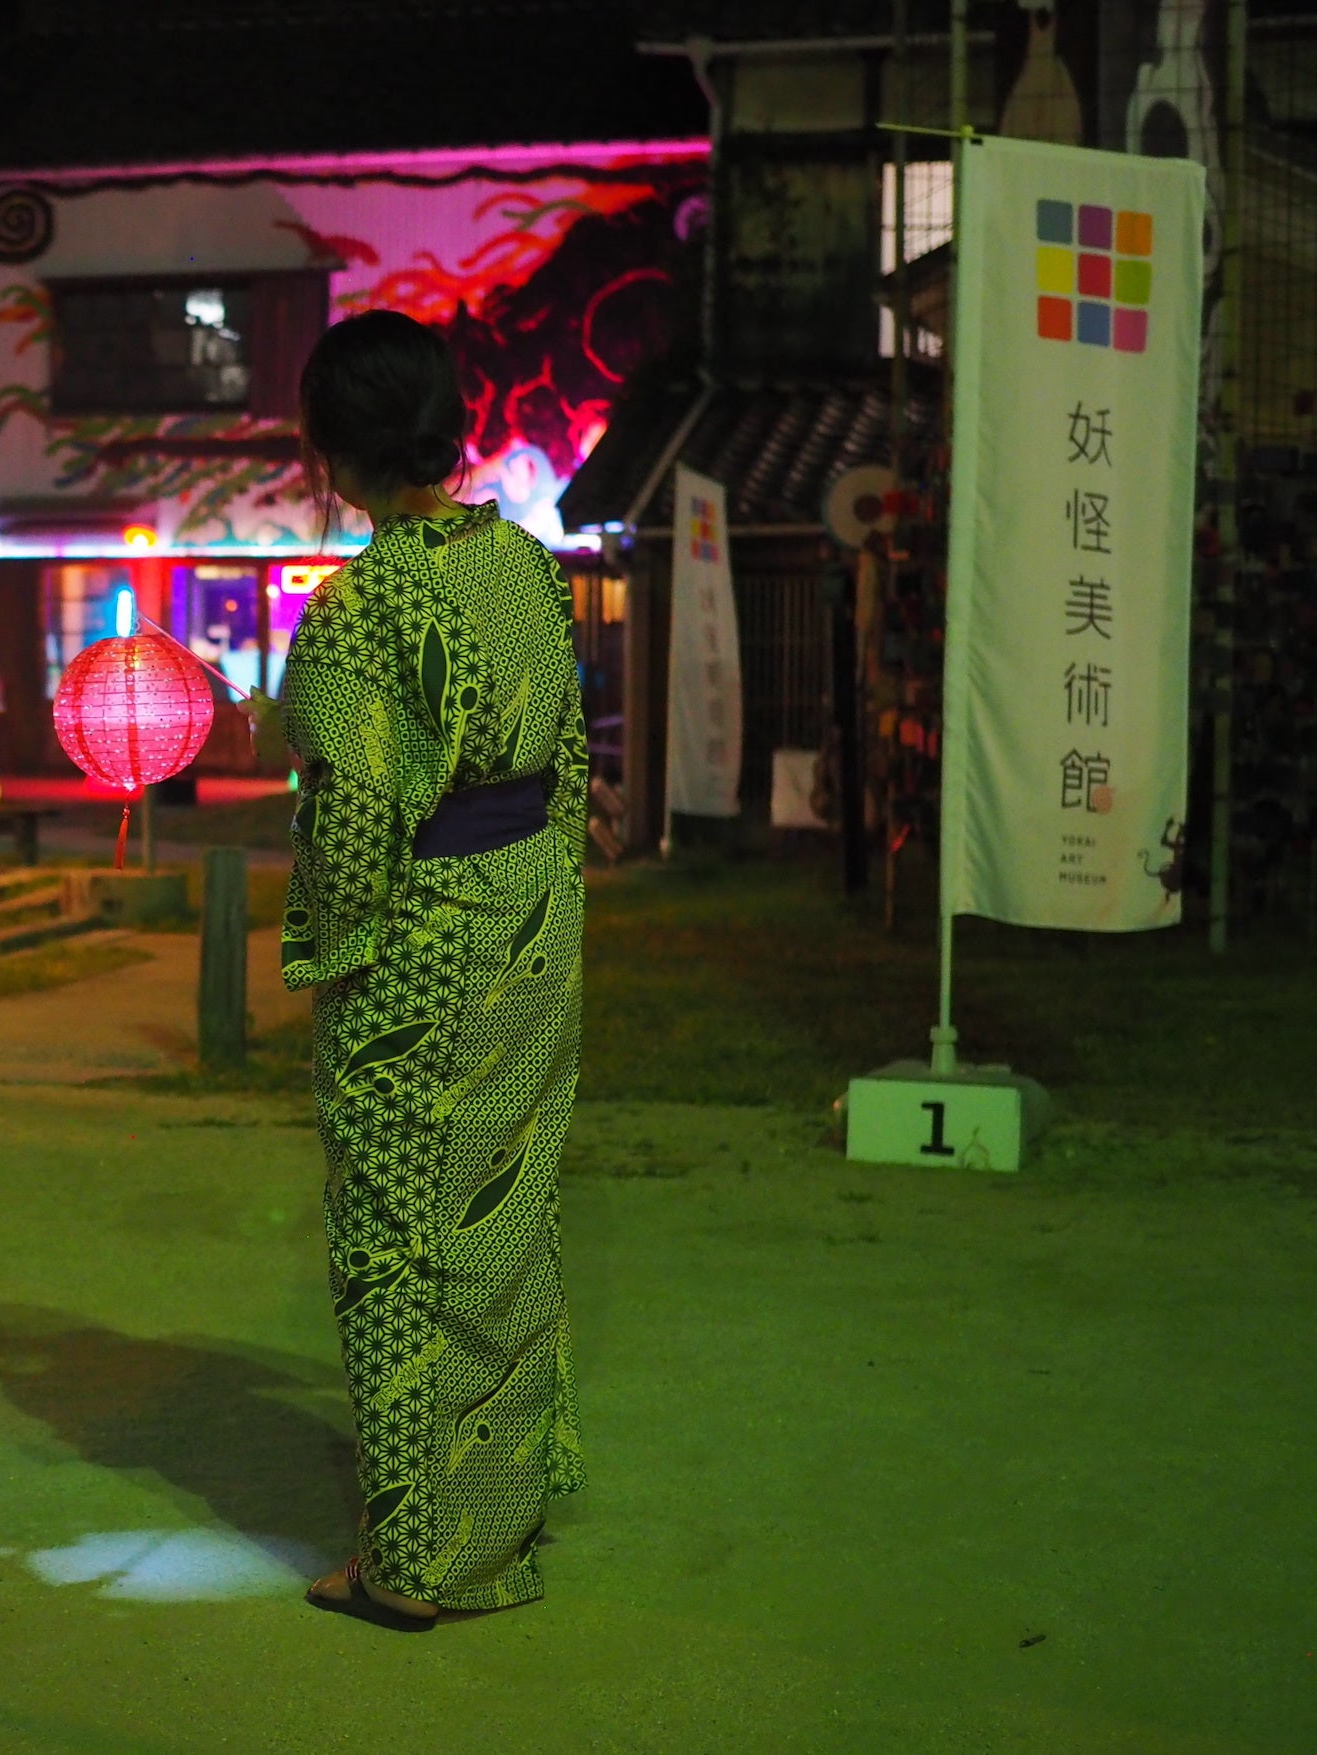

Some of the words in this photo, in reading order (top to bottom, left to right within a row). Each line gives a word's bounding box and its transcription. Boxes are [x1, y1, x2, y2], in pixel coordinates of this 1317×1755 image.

[1060, 401, 1114, 813] 妖怪美術館
[1061, 834, 1096, 847] YOKAI
[1060, 853, 1084, 863] ART
[1058, 871, 1107, 885] MUSEUM
[920, 1102, 955, 1156] 1
